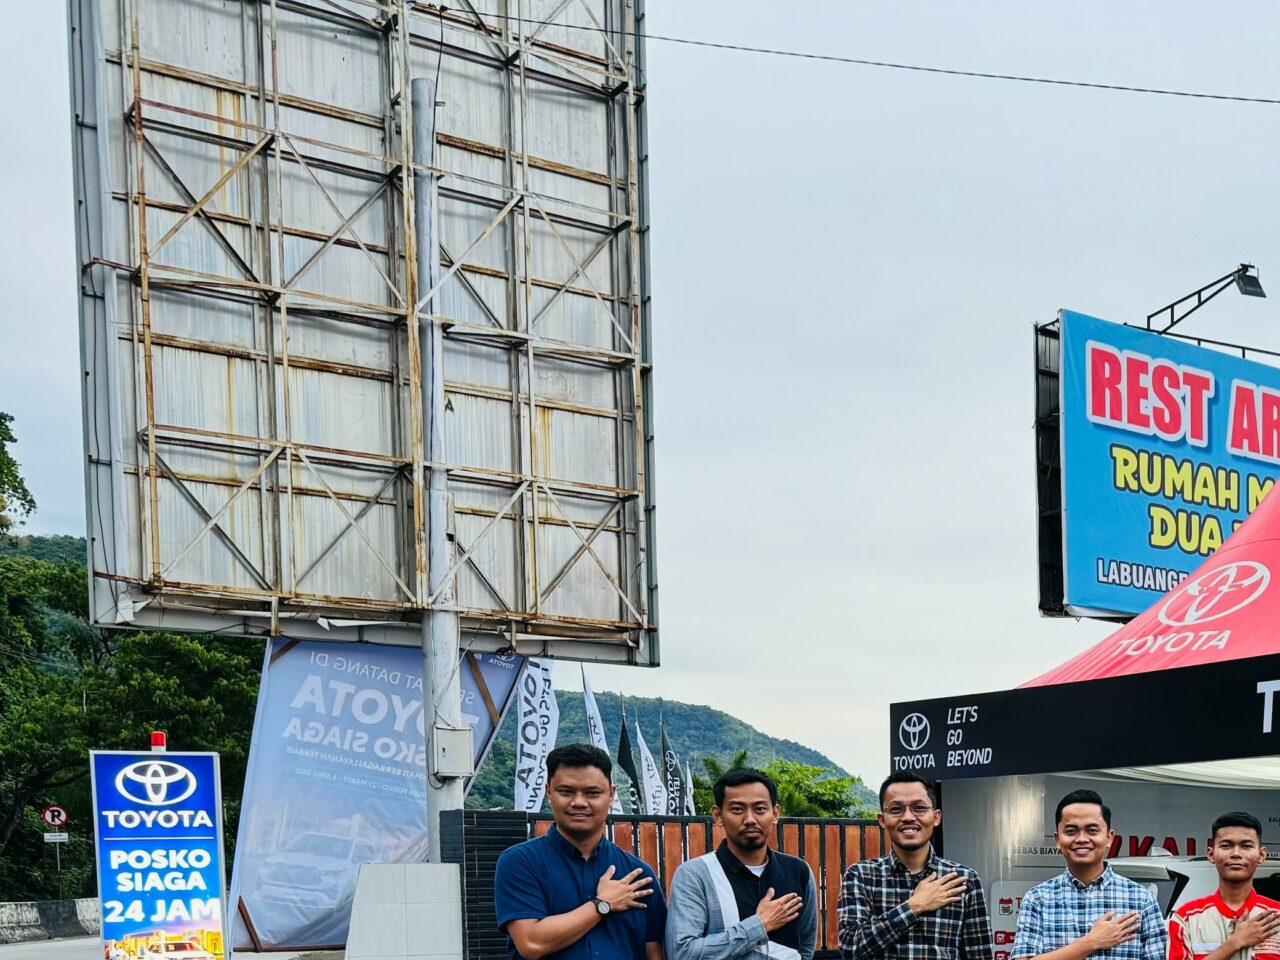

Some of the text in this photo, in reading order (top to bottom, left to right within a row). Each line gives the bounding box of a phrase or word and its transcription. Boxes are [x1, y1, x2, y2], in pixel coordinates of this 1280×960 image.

[1089, 345, 1212, 442] REST
[1110, 446, 1239, 511] RUMAH
[1150, 505, 1224, 555] DUA
[1110, 629, 1233, 657] TOYOTA
[947, 705, 979, 725] LET'S
[946, 729, 963, 746] GO
[893, 753, 936, 771] TOYOTA
[946, 748, 993, 767] BEYOND
[102, 809, 214, 829] TOYOTA
[110, 849, 211, 870] POSKO
[116, 871, 207, 892] SIAGA
[103, 897, 221, 923] 24 JAM
